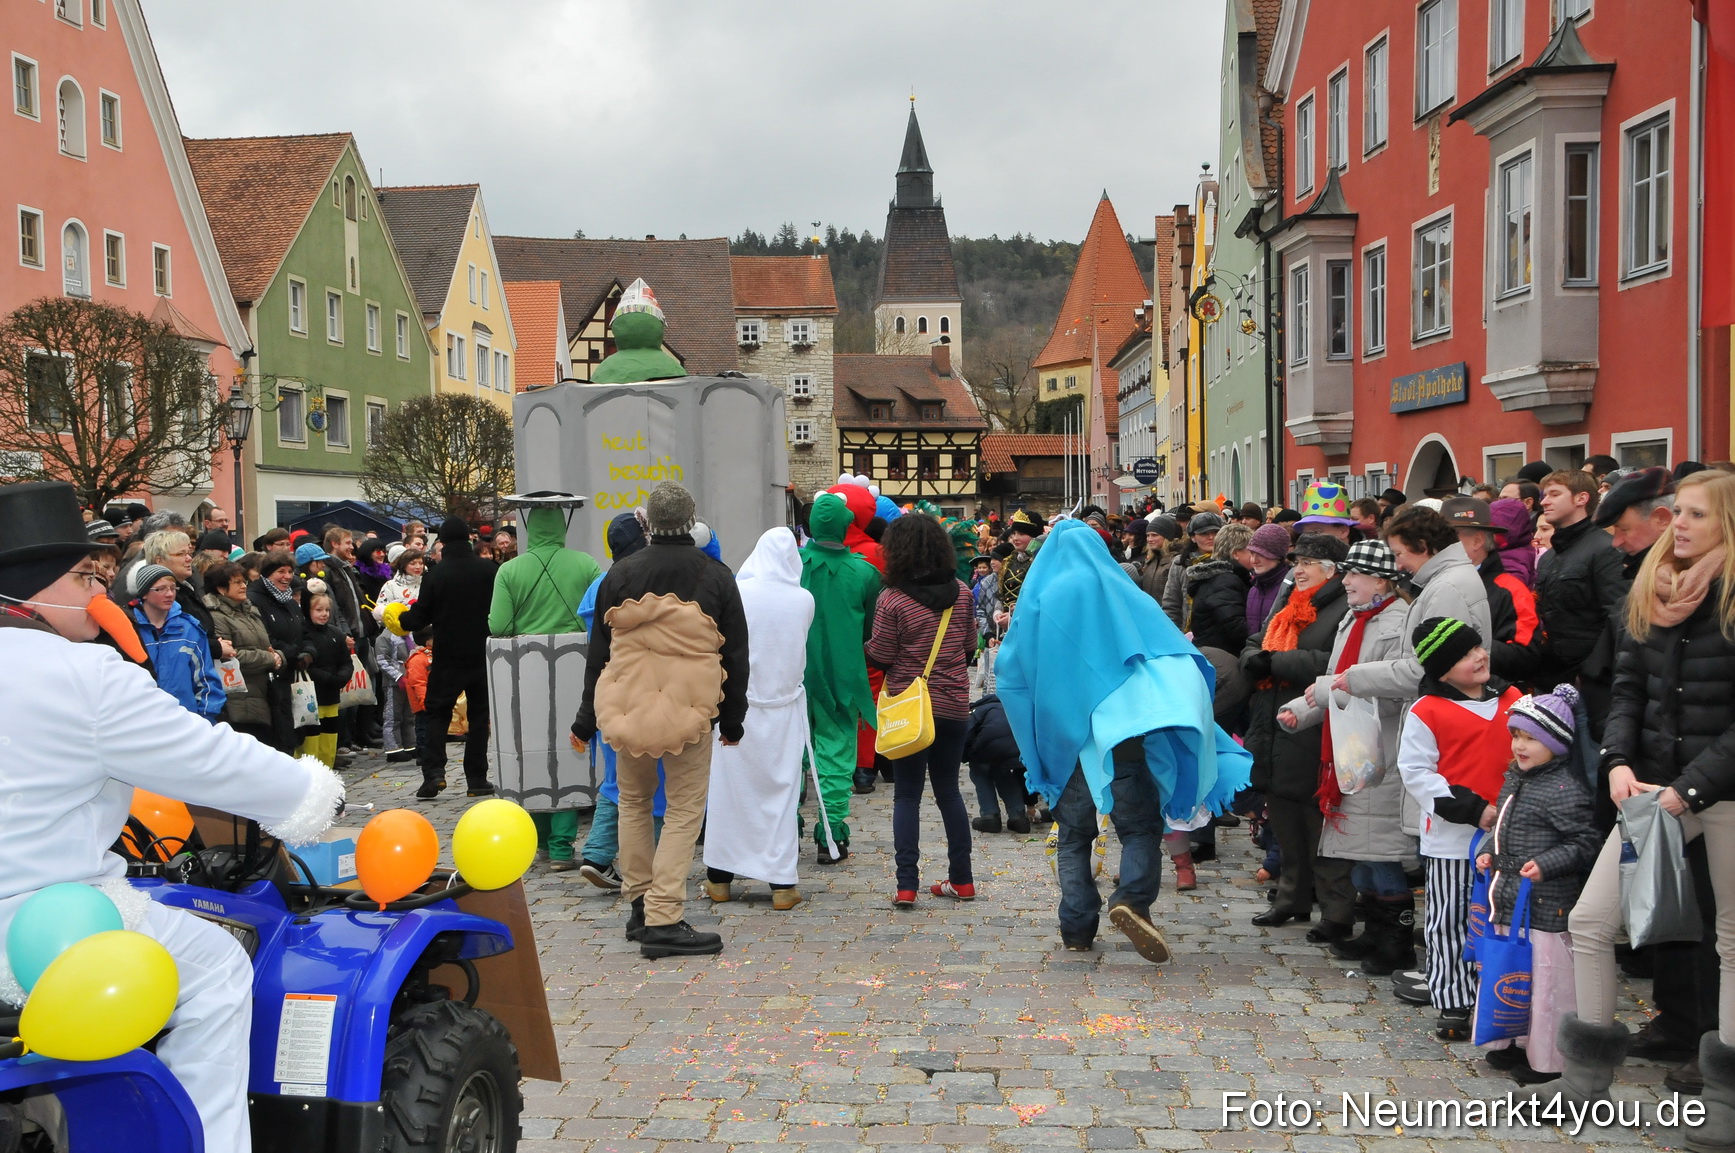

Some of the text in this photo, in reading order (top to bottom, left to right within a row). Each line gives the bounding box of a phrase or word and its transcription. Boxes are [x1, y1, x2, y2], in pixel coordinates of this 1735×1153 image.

[601, 429, 647, 451] heut
[594, 484, 650, 510] euch
[192, 897, 225, 915] YAMAHA
